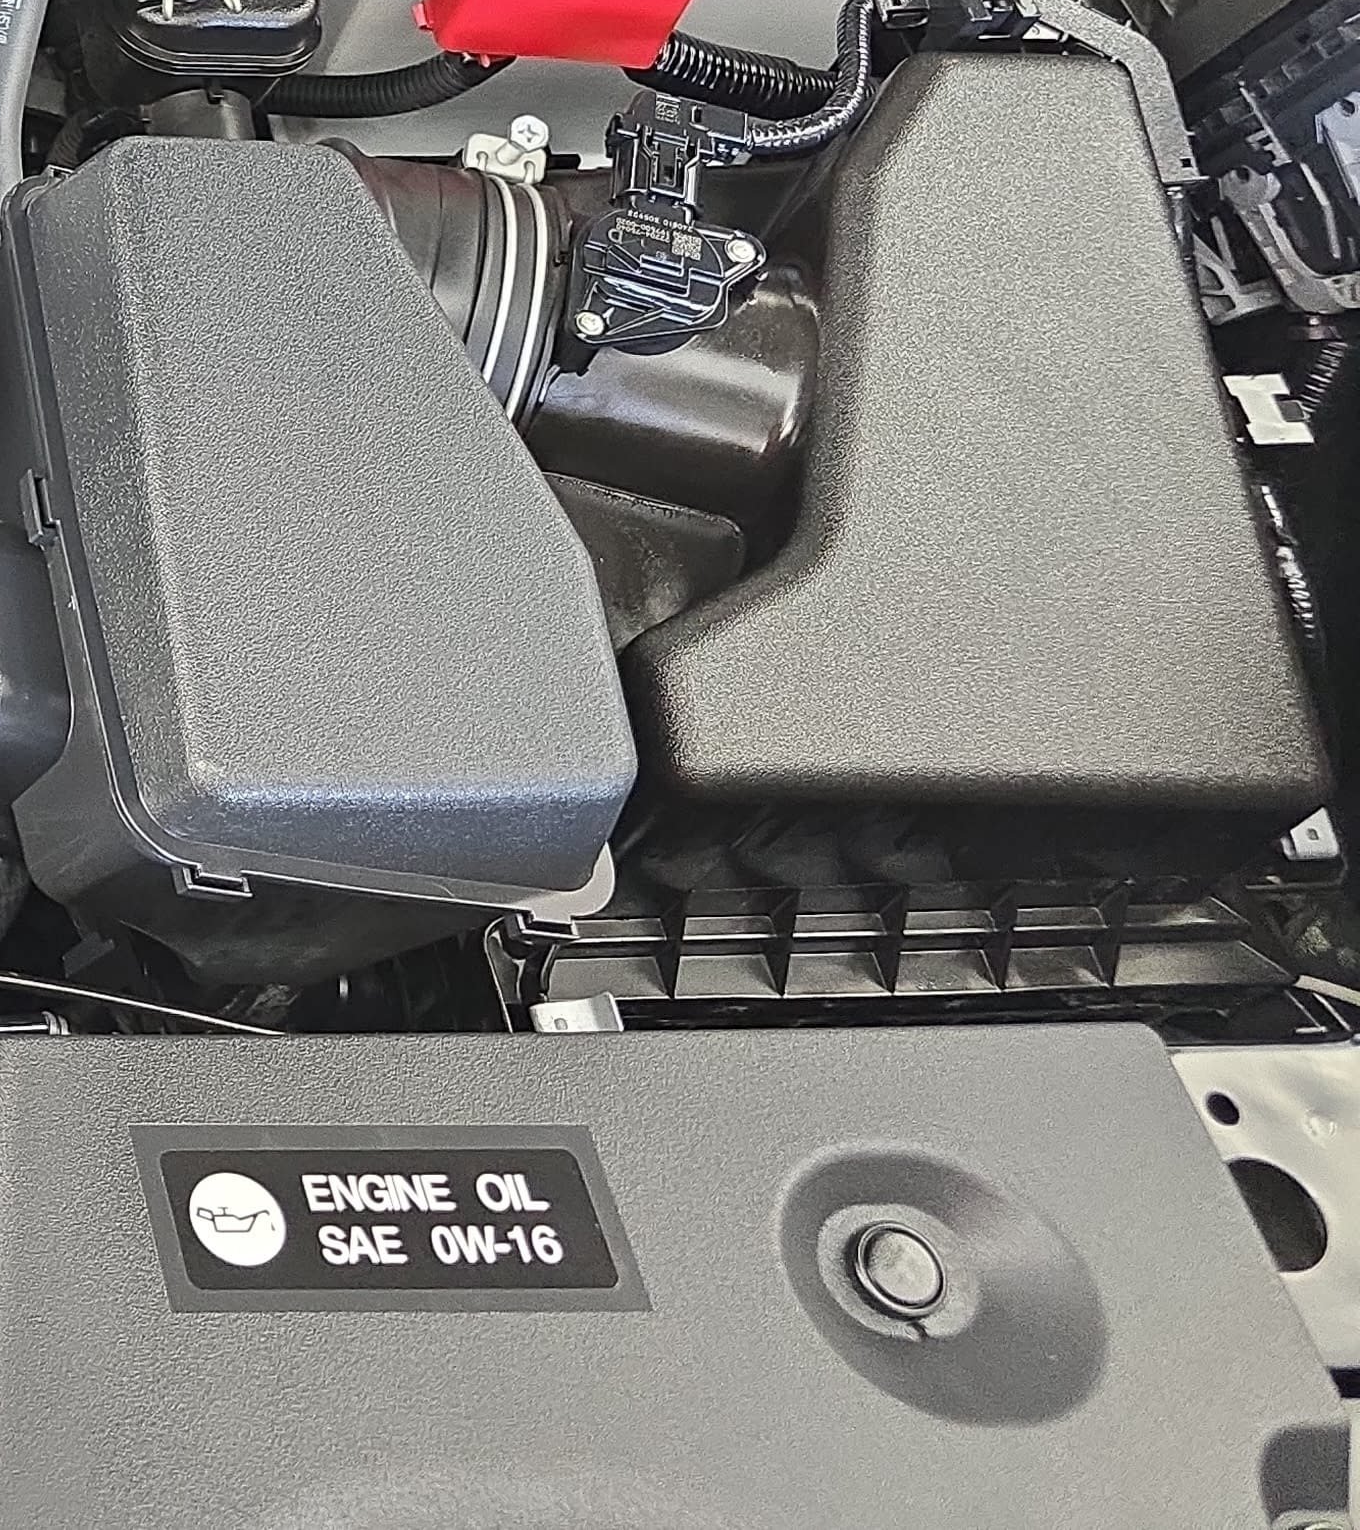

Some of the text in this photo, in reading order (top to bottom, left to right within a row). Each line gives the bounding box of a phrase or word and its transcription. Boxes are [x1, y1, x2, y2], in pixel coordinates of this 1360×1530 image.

[301, 1172, 550, 1212] ENGINE OIL
[317, 1224, 564, 1266] SAE 0W-16
